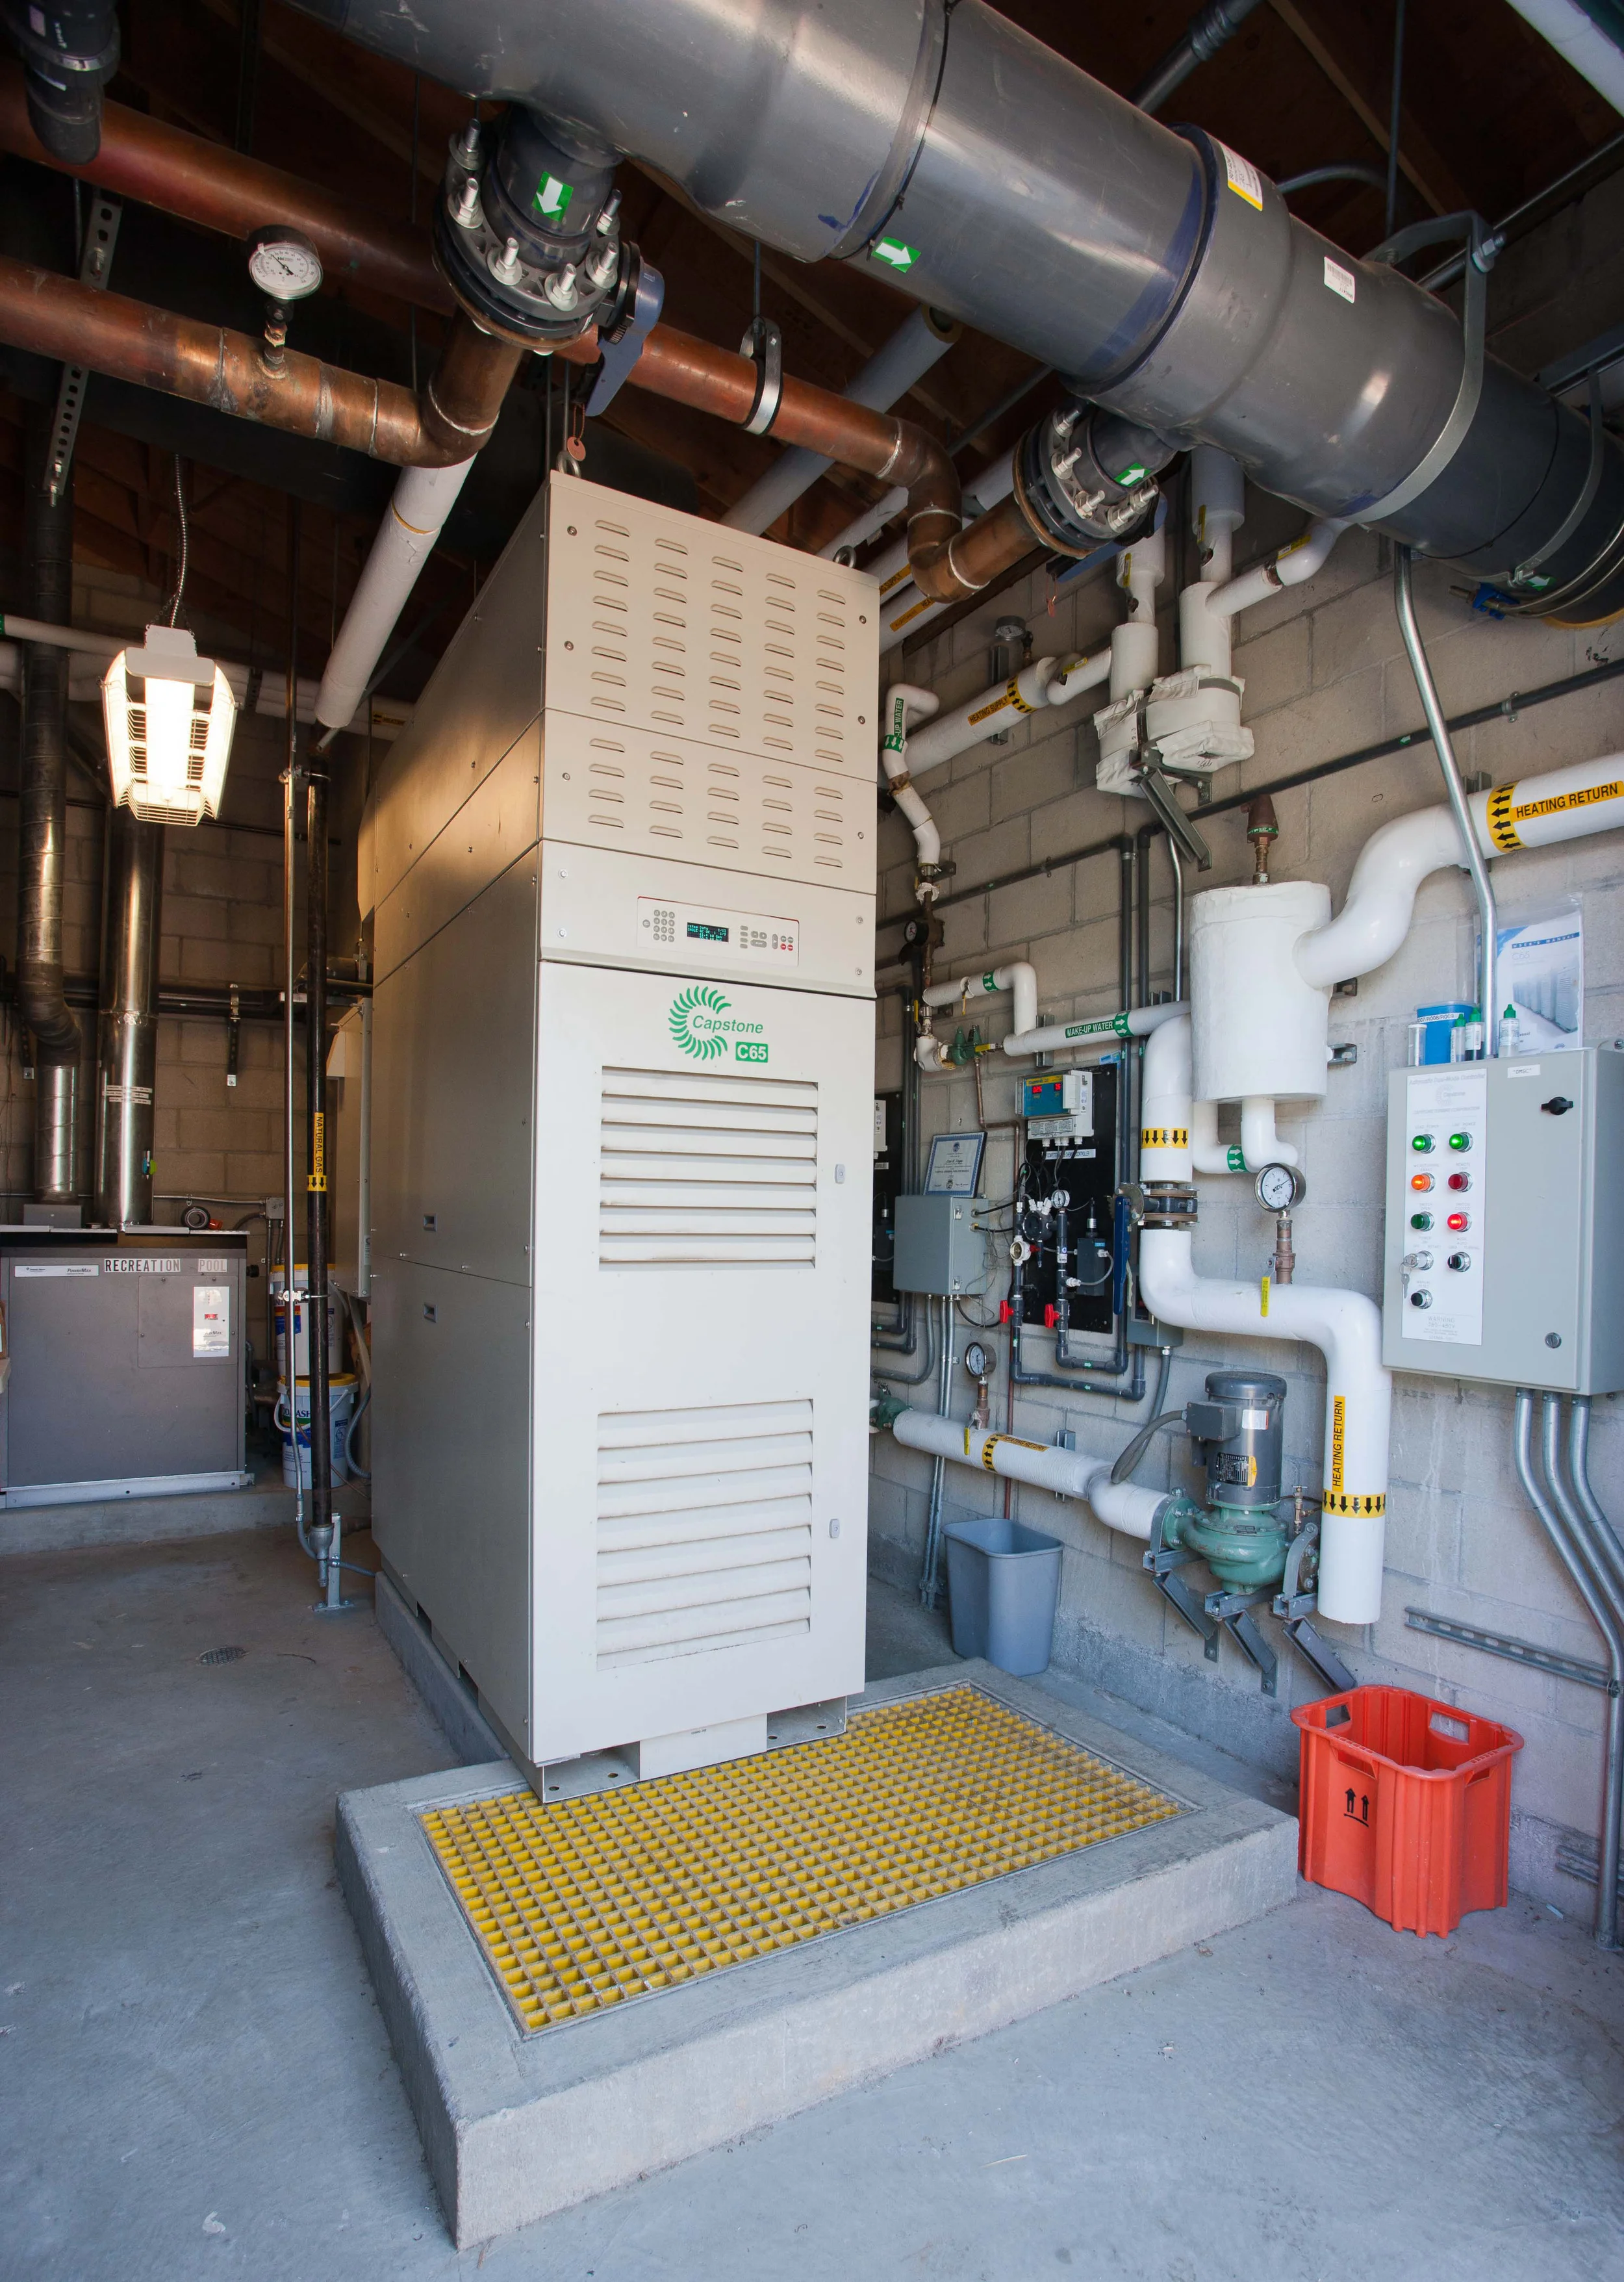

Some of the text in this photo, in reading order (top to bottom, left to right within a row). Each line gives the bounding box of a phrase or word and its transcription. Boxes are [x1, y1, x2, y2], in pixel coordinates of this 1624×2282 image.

[969, 696, 1008, 723] HEATING SUPPLY
[1516, 783, 1618, 818] HEATING RETURN
[692, 1015, 763, 1034] Capstone
[1067, 1021, 1113, 1037] MAKE-UP WATER
[737, 1044, 767, 1060] C65
[105, 1260, 227, 1272] RECREATION POOL
[1332, 1401, 1343, 1487] HEATING RETURN
